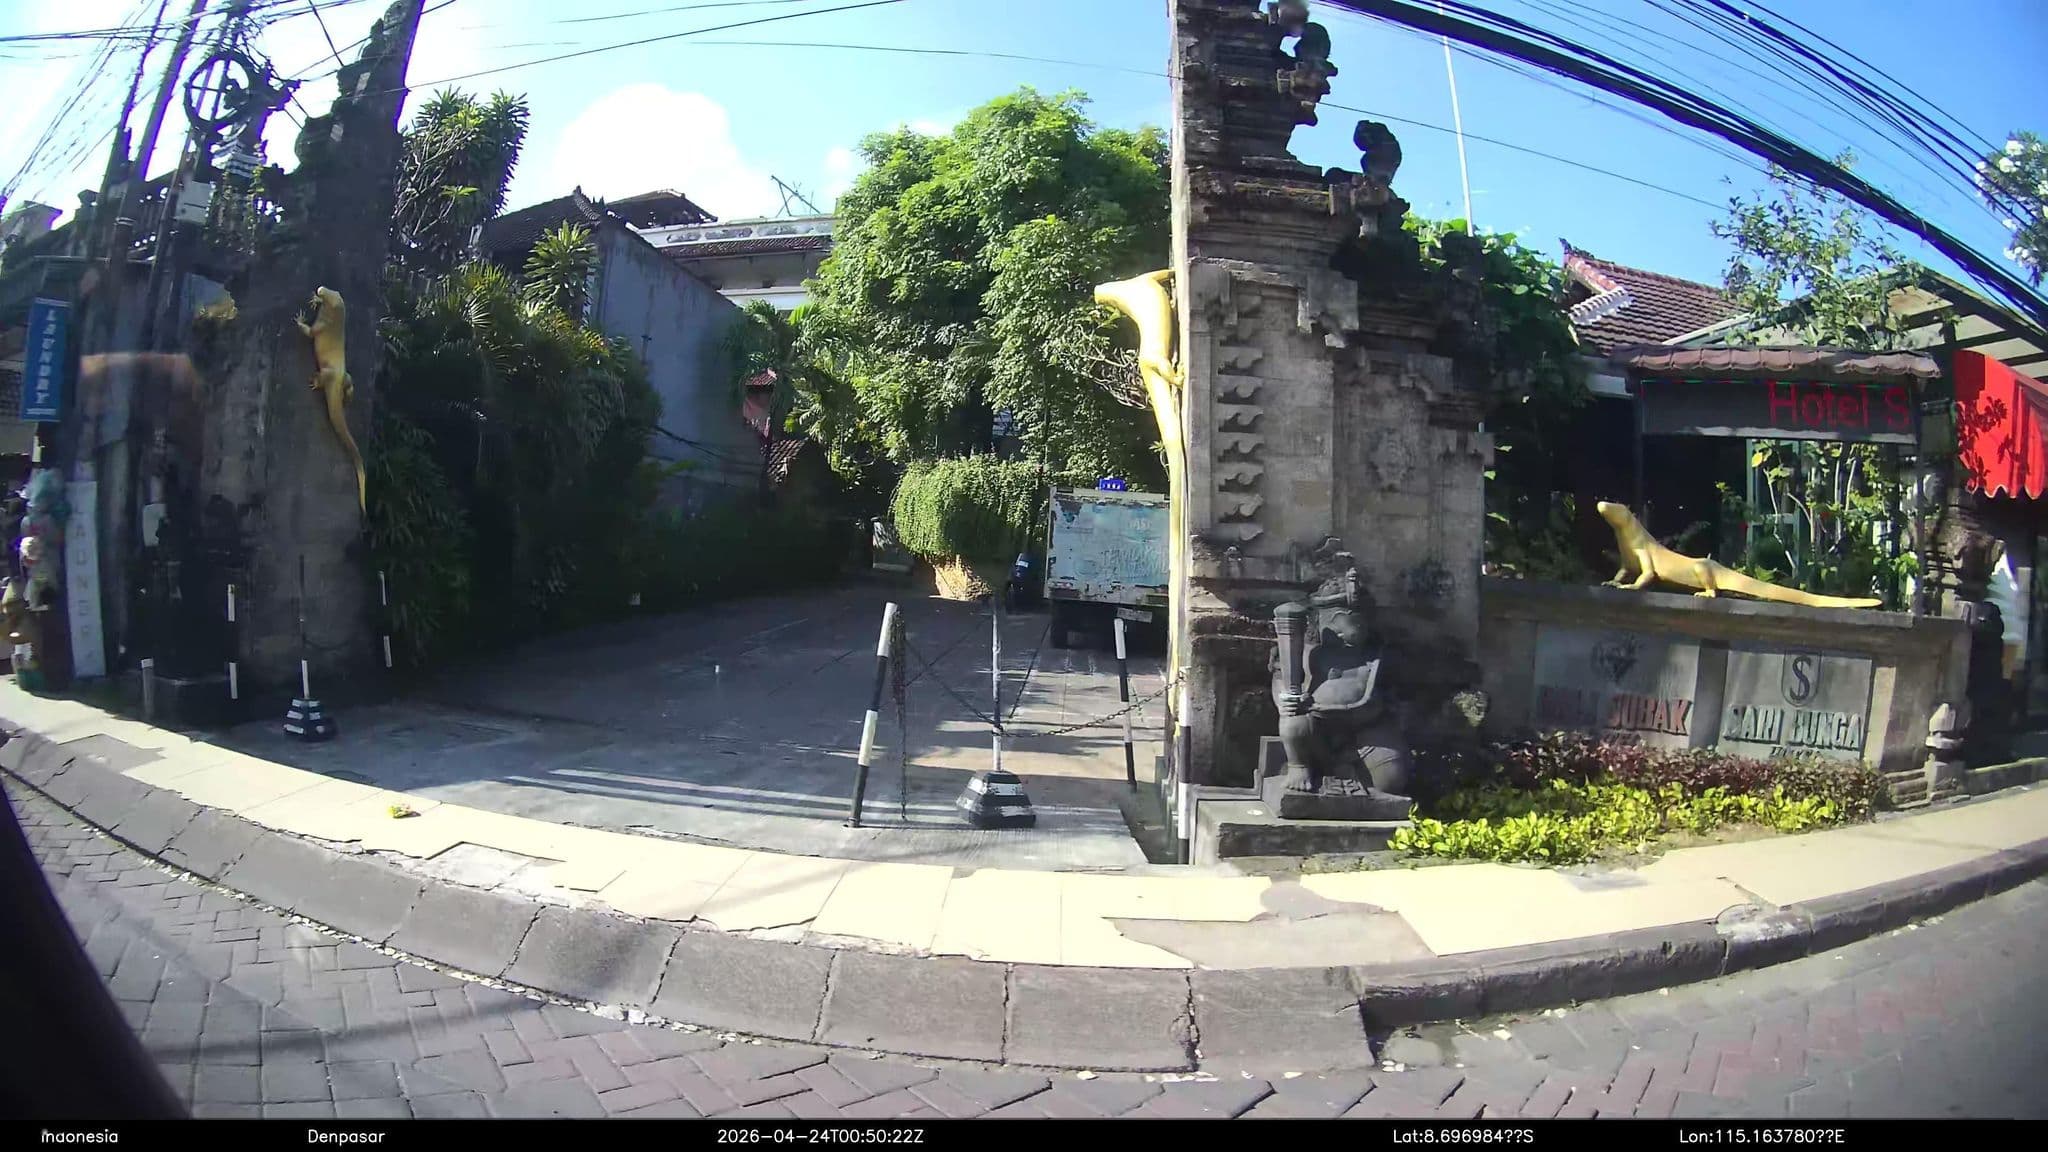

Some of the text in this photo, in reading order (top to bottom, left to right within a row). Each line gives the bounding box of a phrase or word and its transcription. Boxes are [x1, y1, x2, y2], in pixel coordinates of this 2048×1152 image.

[35, 308, 57, 404] LAUNDRY
[1767, 380, 1911, 431] Hotel S
[1791, 709, 1863, 752] BUNGA
